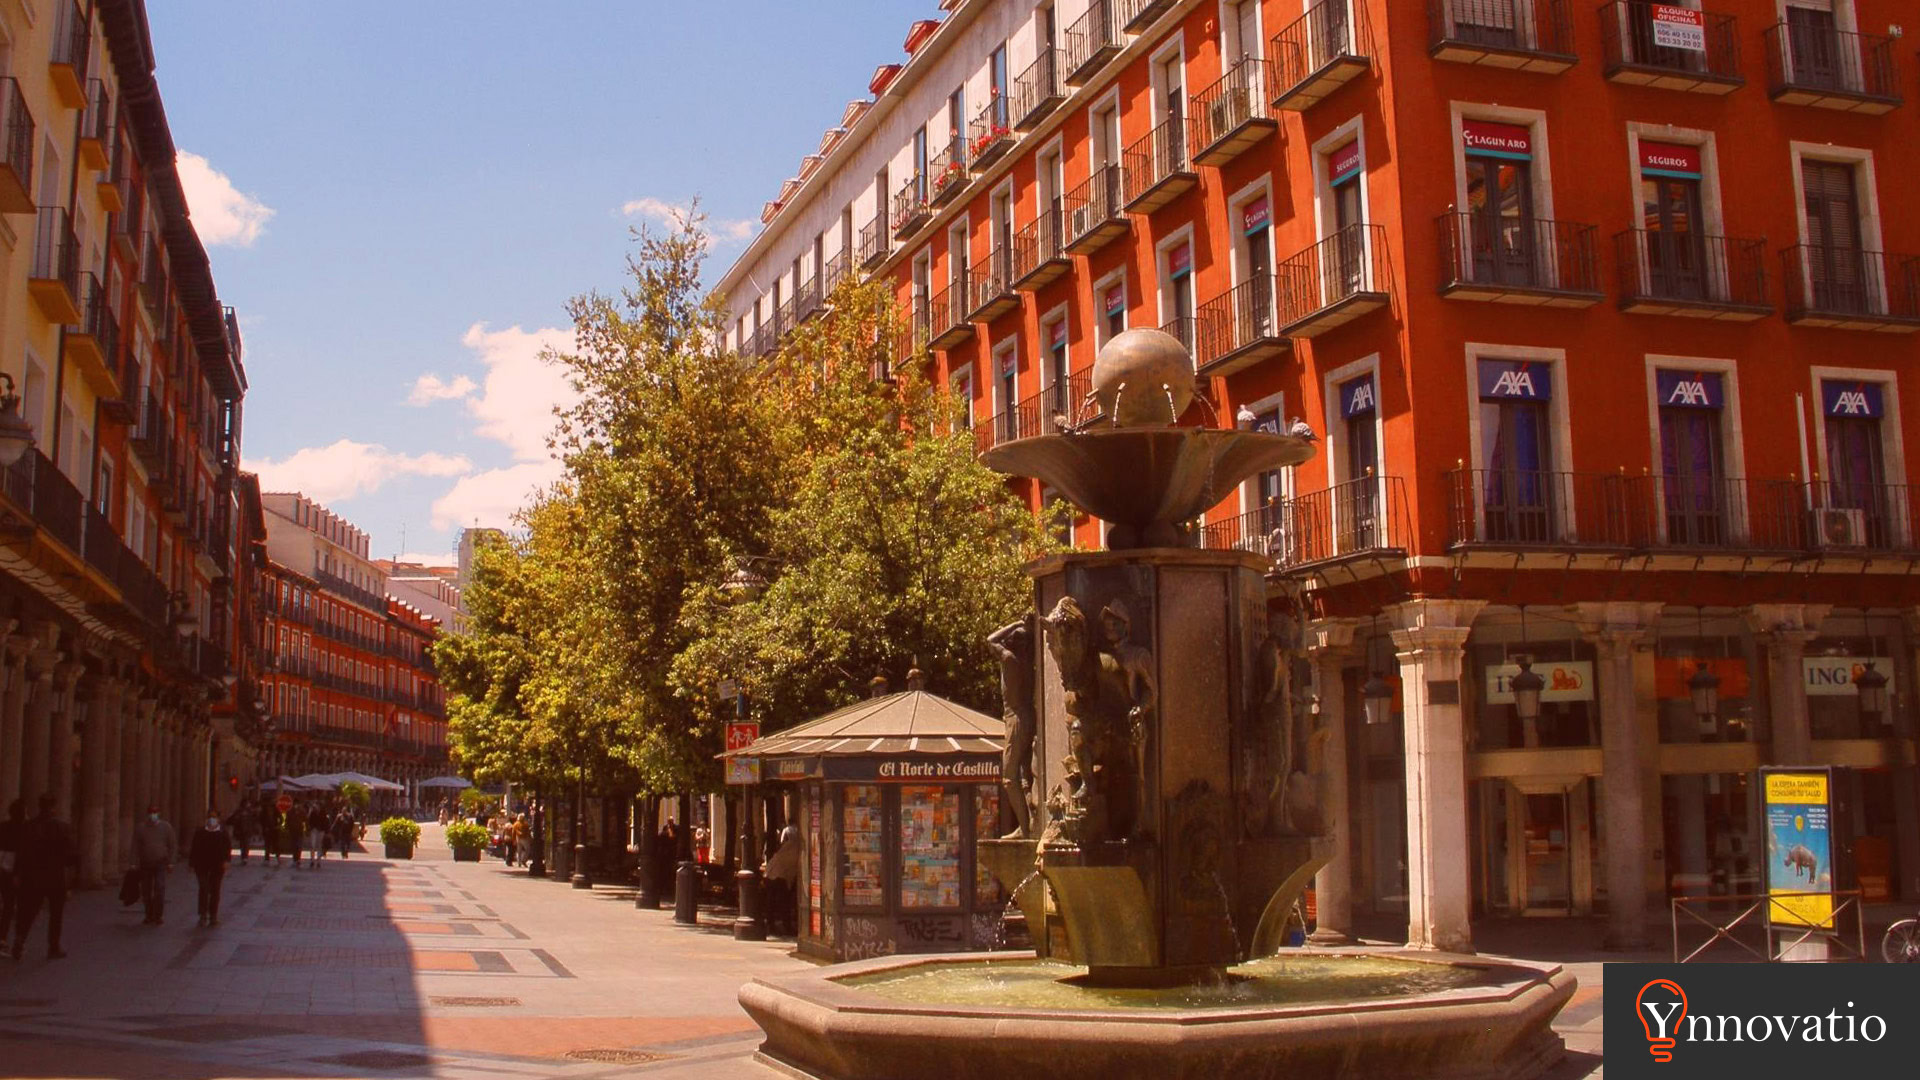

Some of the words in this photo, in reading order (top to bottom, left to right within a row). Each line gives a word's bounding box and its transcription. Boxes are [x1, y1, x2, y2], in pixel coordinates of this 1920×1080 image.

[1657, 14, 1697, 25] OFICINAS
[1658, 7, 1695, 18] ALQUILO
[1474, 135, 1505, 147] LAGUN
[1507, 139, 1527, 149] ARO
[1648, 155, 1688, 167] SEGUROS
[1491, 370, 1535, 396] AXA
[1349, 383, 1374, 414] AXA
[1668, 381, 1709, 405] AXA
[1833, 391, 1870, 414] AXA
[1808, 667, 1847, 685] ING
[879, 761, 895, 776] El
[900, 761, 934, 776] Norte
[937, 762, 951, 776] de
[952, 761, 1000, 776] Castilla
